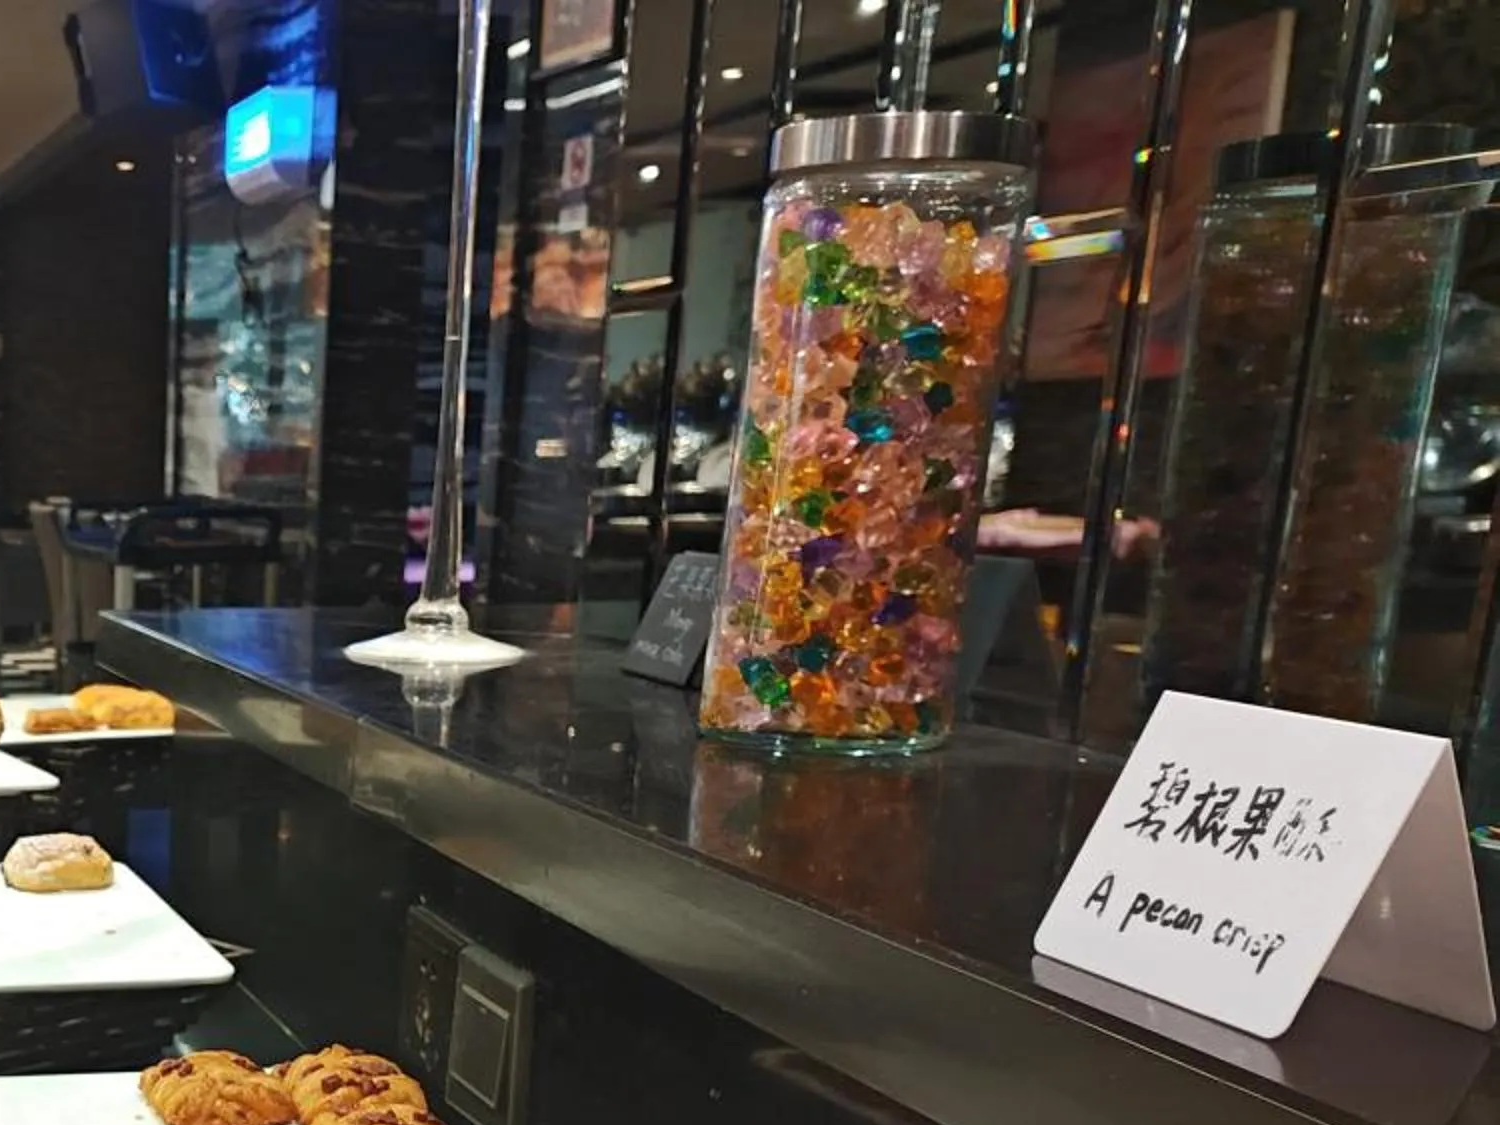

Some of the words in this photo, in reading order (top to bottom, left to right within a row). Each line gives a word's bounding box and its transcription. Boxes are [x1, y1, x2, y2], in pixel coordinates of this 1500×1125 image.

[1084, 873, 1115, 917] A
[1118, 892, 1204, 935] pecan
[1212, 918, 1285, 974] crisp
